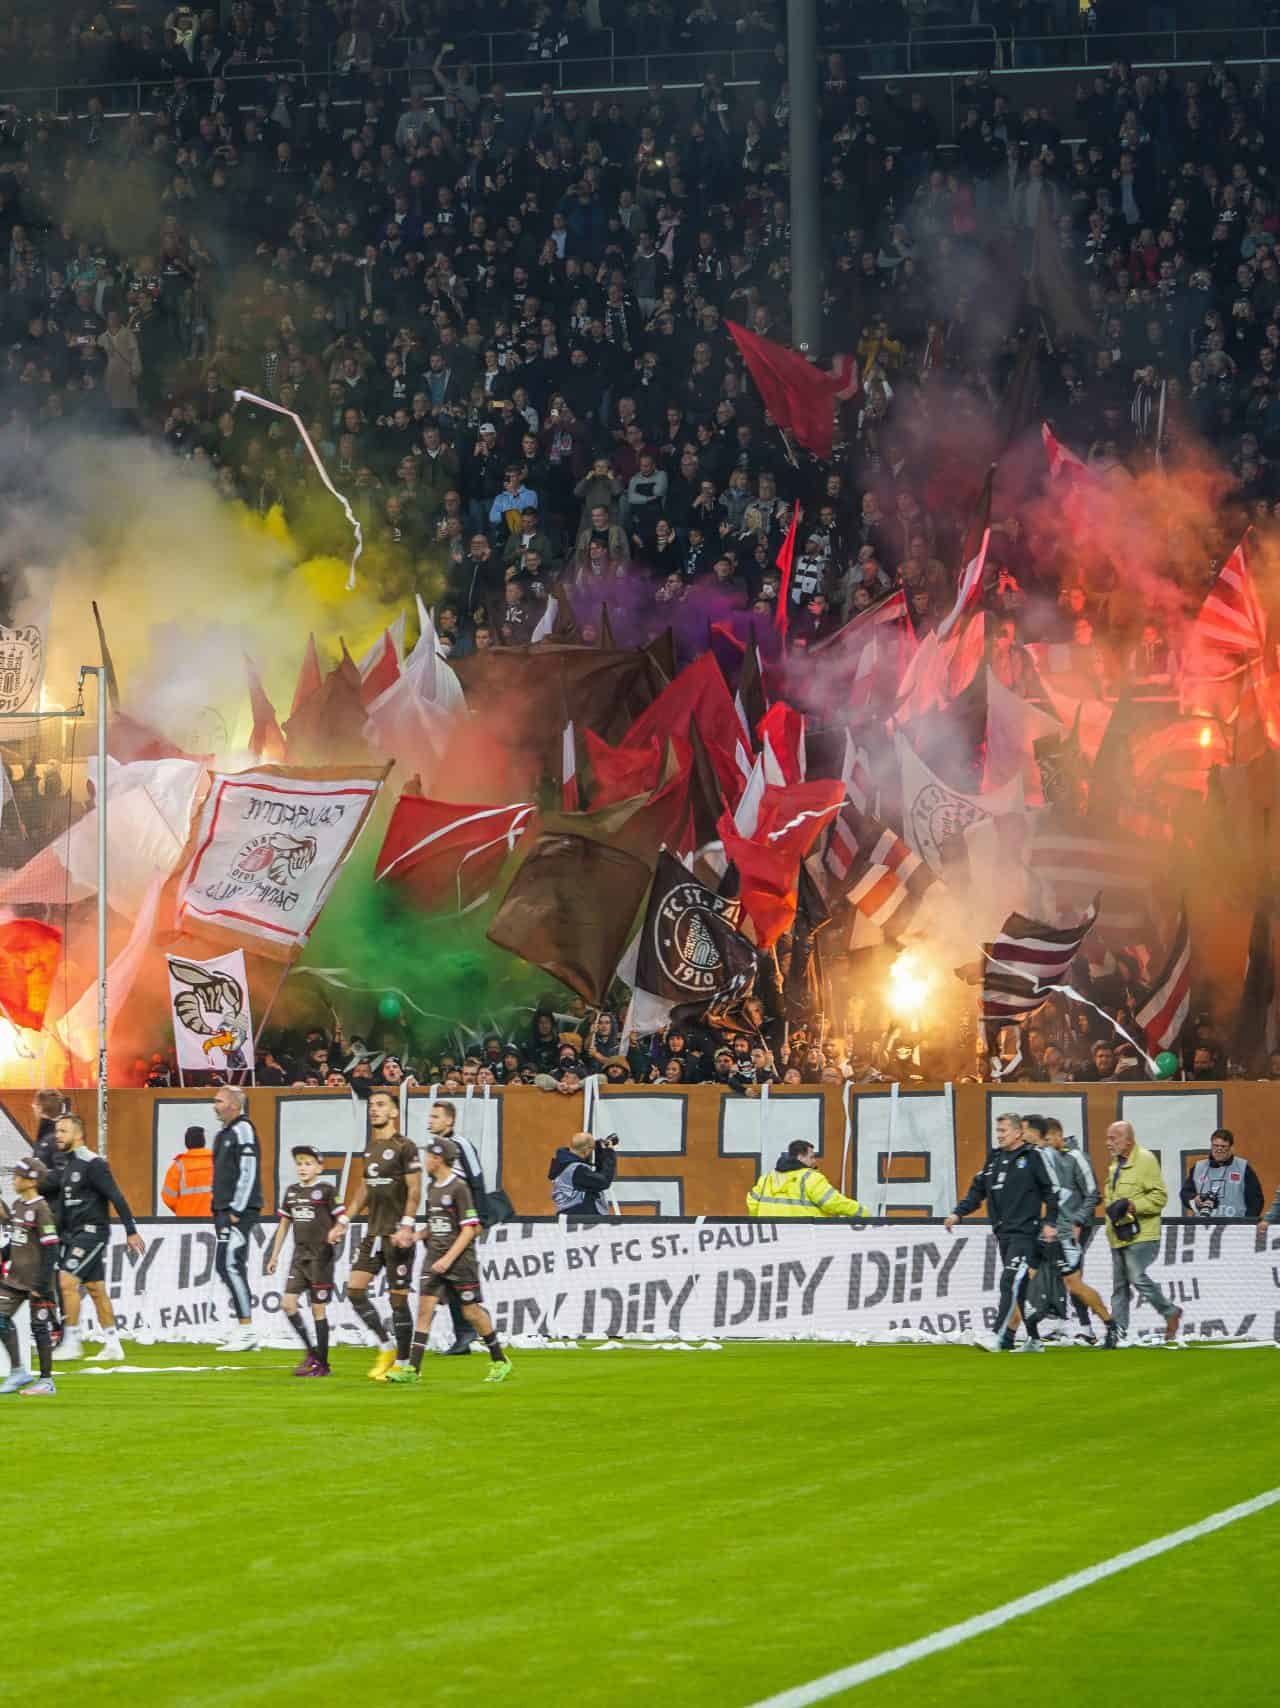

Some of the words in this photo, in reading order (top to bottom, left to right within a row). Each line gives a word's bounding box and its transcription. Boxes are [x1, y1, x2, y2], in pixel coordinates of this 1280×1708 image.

[663, 898, 684, 921] FC
[684, 889, 708, 905] ST.
[673, 962, 715, 985] 1910
[482, 1250, 554, 1283] MADE
[566, 1244, 600, 1270] BY
[611, 1238, 642, 1264] FC
[651, 1233, 688, 1259] ST.
[698, 1222, 778, 1252] PAULI
[160, 1302, 218, 1328] FAIR
